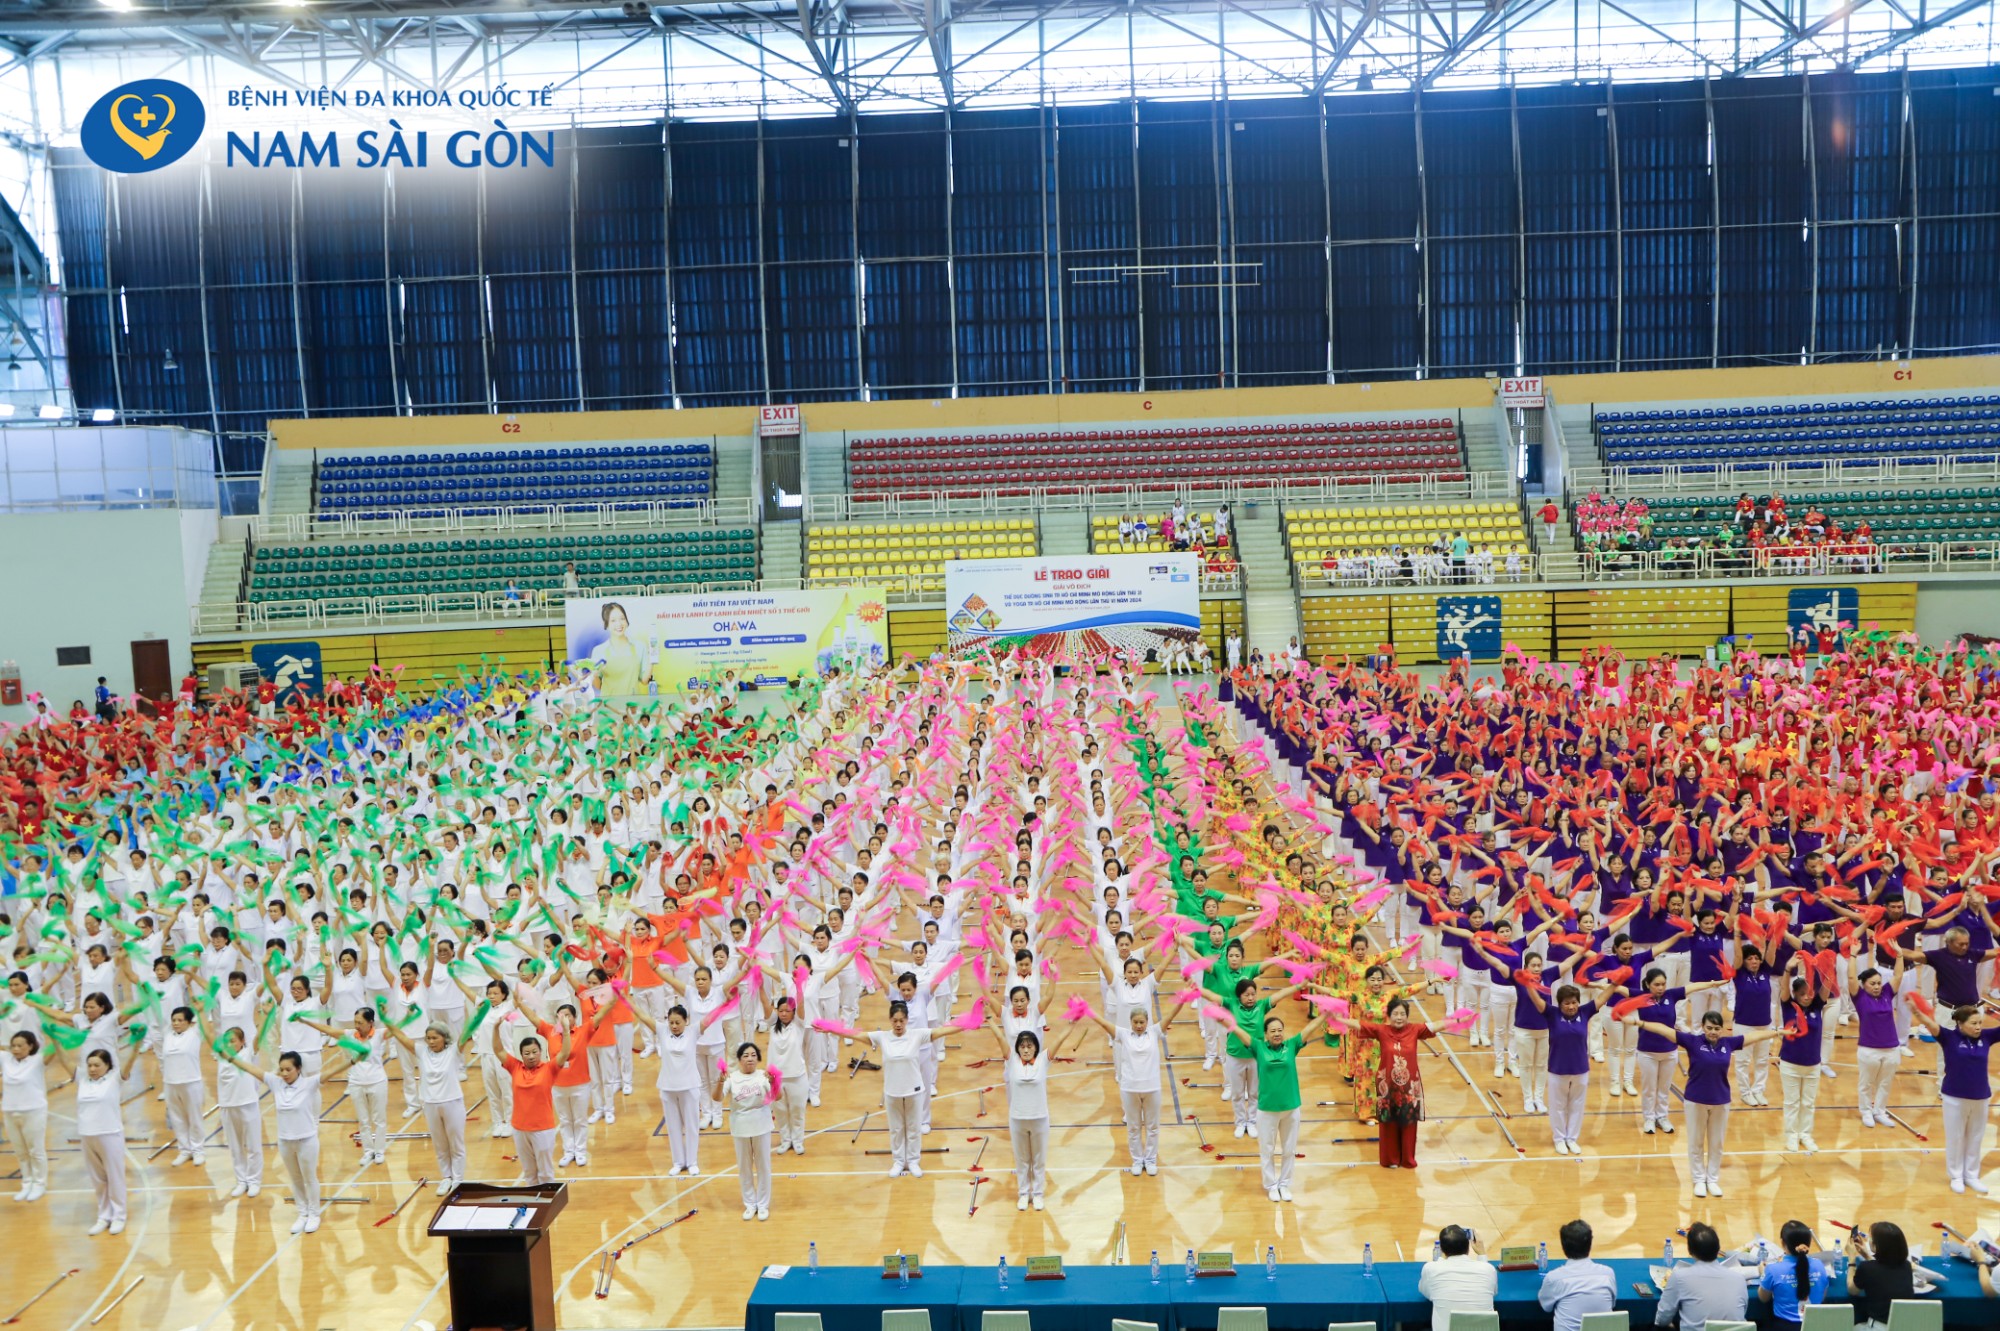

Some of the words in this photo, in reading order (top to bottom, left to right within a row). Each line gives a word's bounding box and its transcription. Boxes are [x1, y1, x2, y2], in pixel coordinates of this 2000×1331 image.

[1893, 370, 1912, 381] C1
[1504, 380, 1539, 393] EXIT
[1143, 400, 1153, 411] C
[763, 407, 796, 420] EXIT
[501, 423, 521, 433] C2
[1034, 566, 1048, 581] LỄ
[1051, 569, 1083, 580] TRAO
[1087, 565, 1110, 579] GIẢI
[861, 607, 882, 617] NEW
[713, 621, 757, 632] OHAWA
